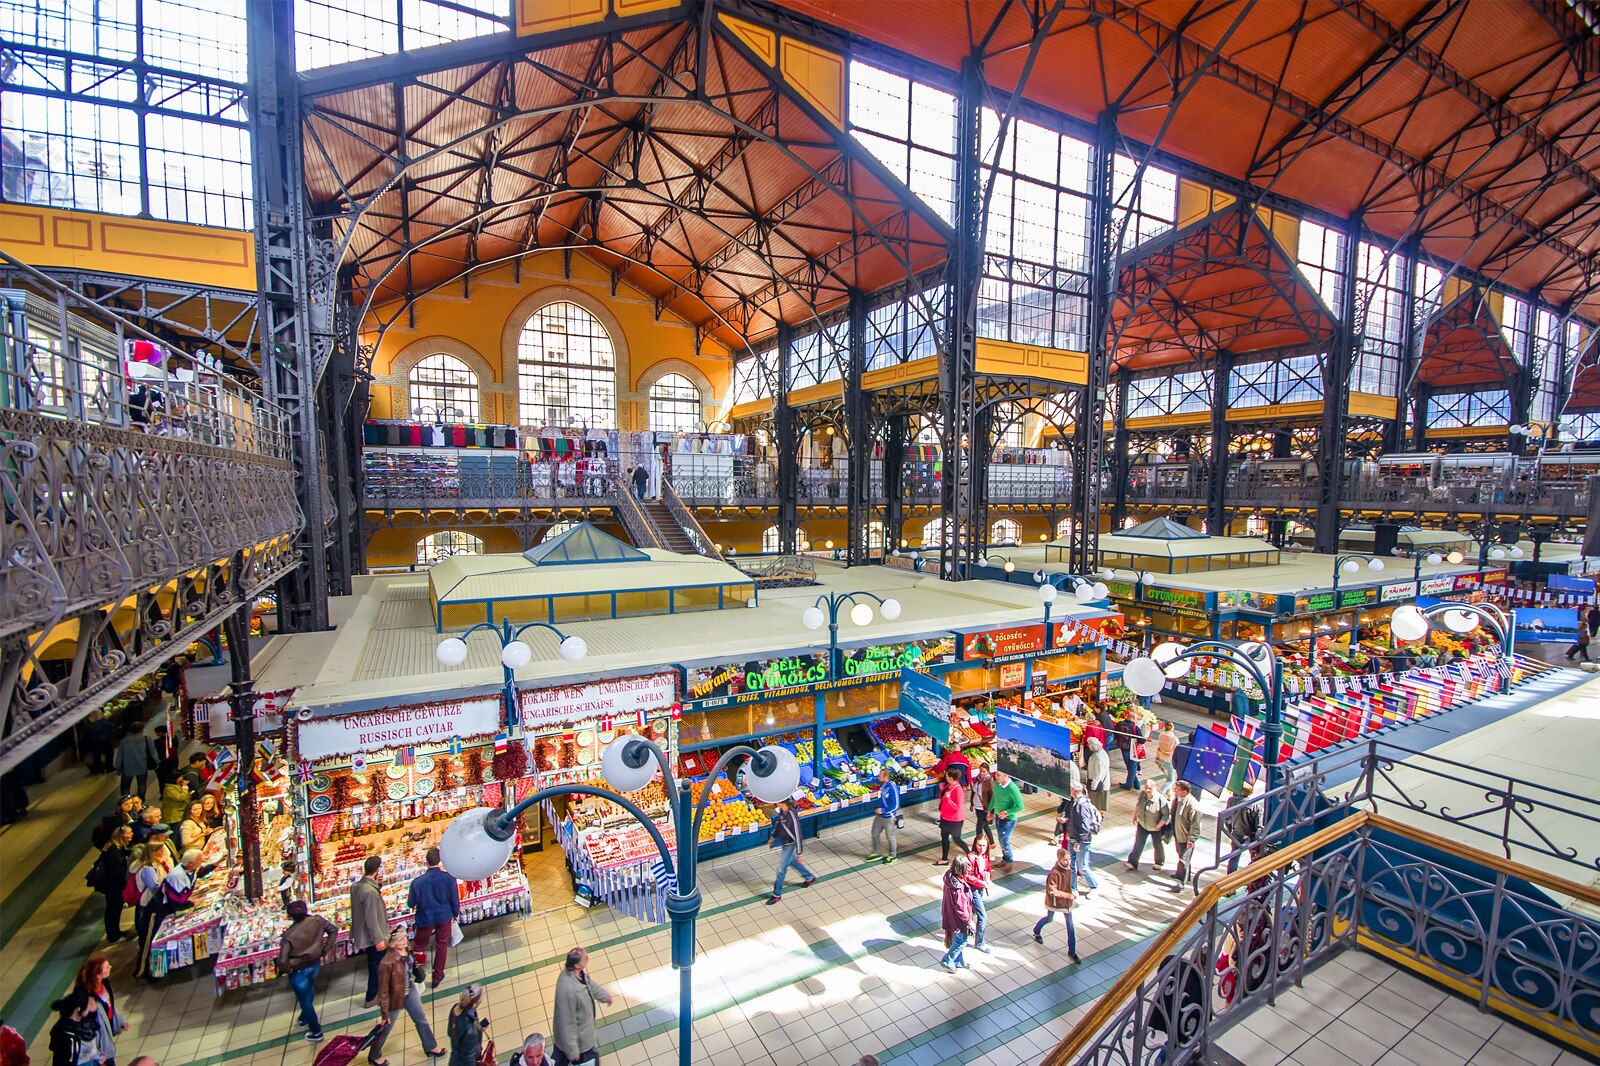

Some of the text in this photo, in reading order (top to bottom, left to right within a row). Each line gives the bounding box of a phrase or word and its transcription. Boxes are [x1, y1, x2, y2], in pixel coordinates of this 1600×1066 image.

[845, 650, 913, 676] GYÜMÖLCS
[691, 666, 738, 699] Narancs
[746, 662, 826, 691] GYÜMÖLCS
[522, 688, 584, 706] TOKAJER WEIN
[598, 680, 650, 695] UNGARISCHER
[1033, 686, 1041, 697] 80
[636, 692, 664, 704] SAFRAN
[343, 711, 412, 730] UNGARISCHE
[359, 728, 412, 744] RUSSISCH
[415, 721, 454, 736] CAVIAR
